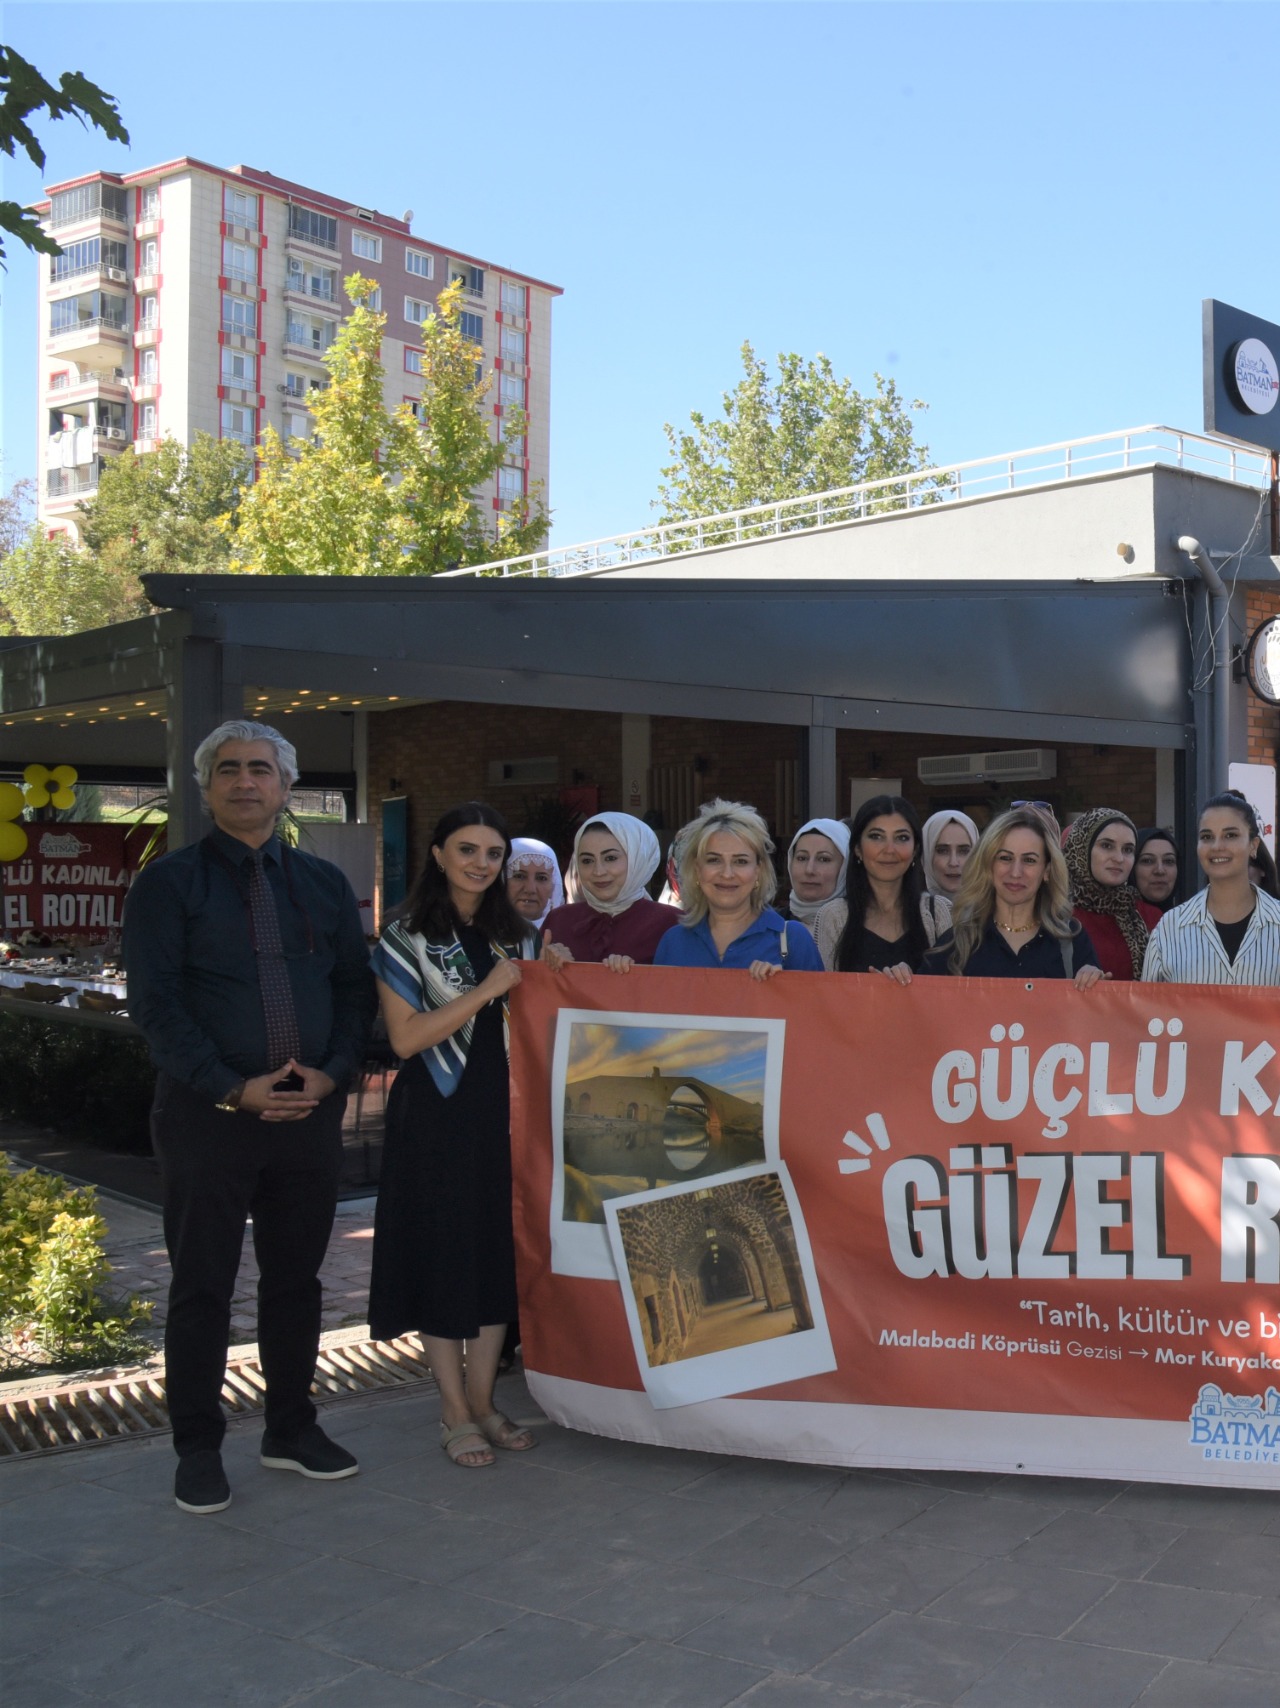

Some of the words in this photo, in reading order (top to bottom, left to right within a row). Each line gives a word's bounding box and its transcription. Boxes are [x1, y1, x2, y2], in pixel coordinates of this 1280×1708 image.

[1236, 366, 1273, 391] BATMAN
[41, 864, 138, 888] KADINLA
[42, 893, 124, 927] ROTAL
[931, 1017, 1187, 1139] GÜÇLÜ
[882, 1144, 1188, 1281] GÜZEL
[1118, 1306, 1210, 1336] kültür
[1217, 1320, 1251, 1338] ve
[878, 1329, 976, 1351] Malabadi
[981, 1334, 1061, 1357] Köprüsü
[1066, 1340, 1123, 1360] Gezisi
[1155, 1347, 1196, 1366] Mor
